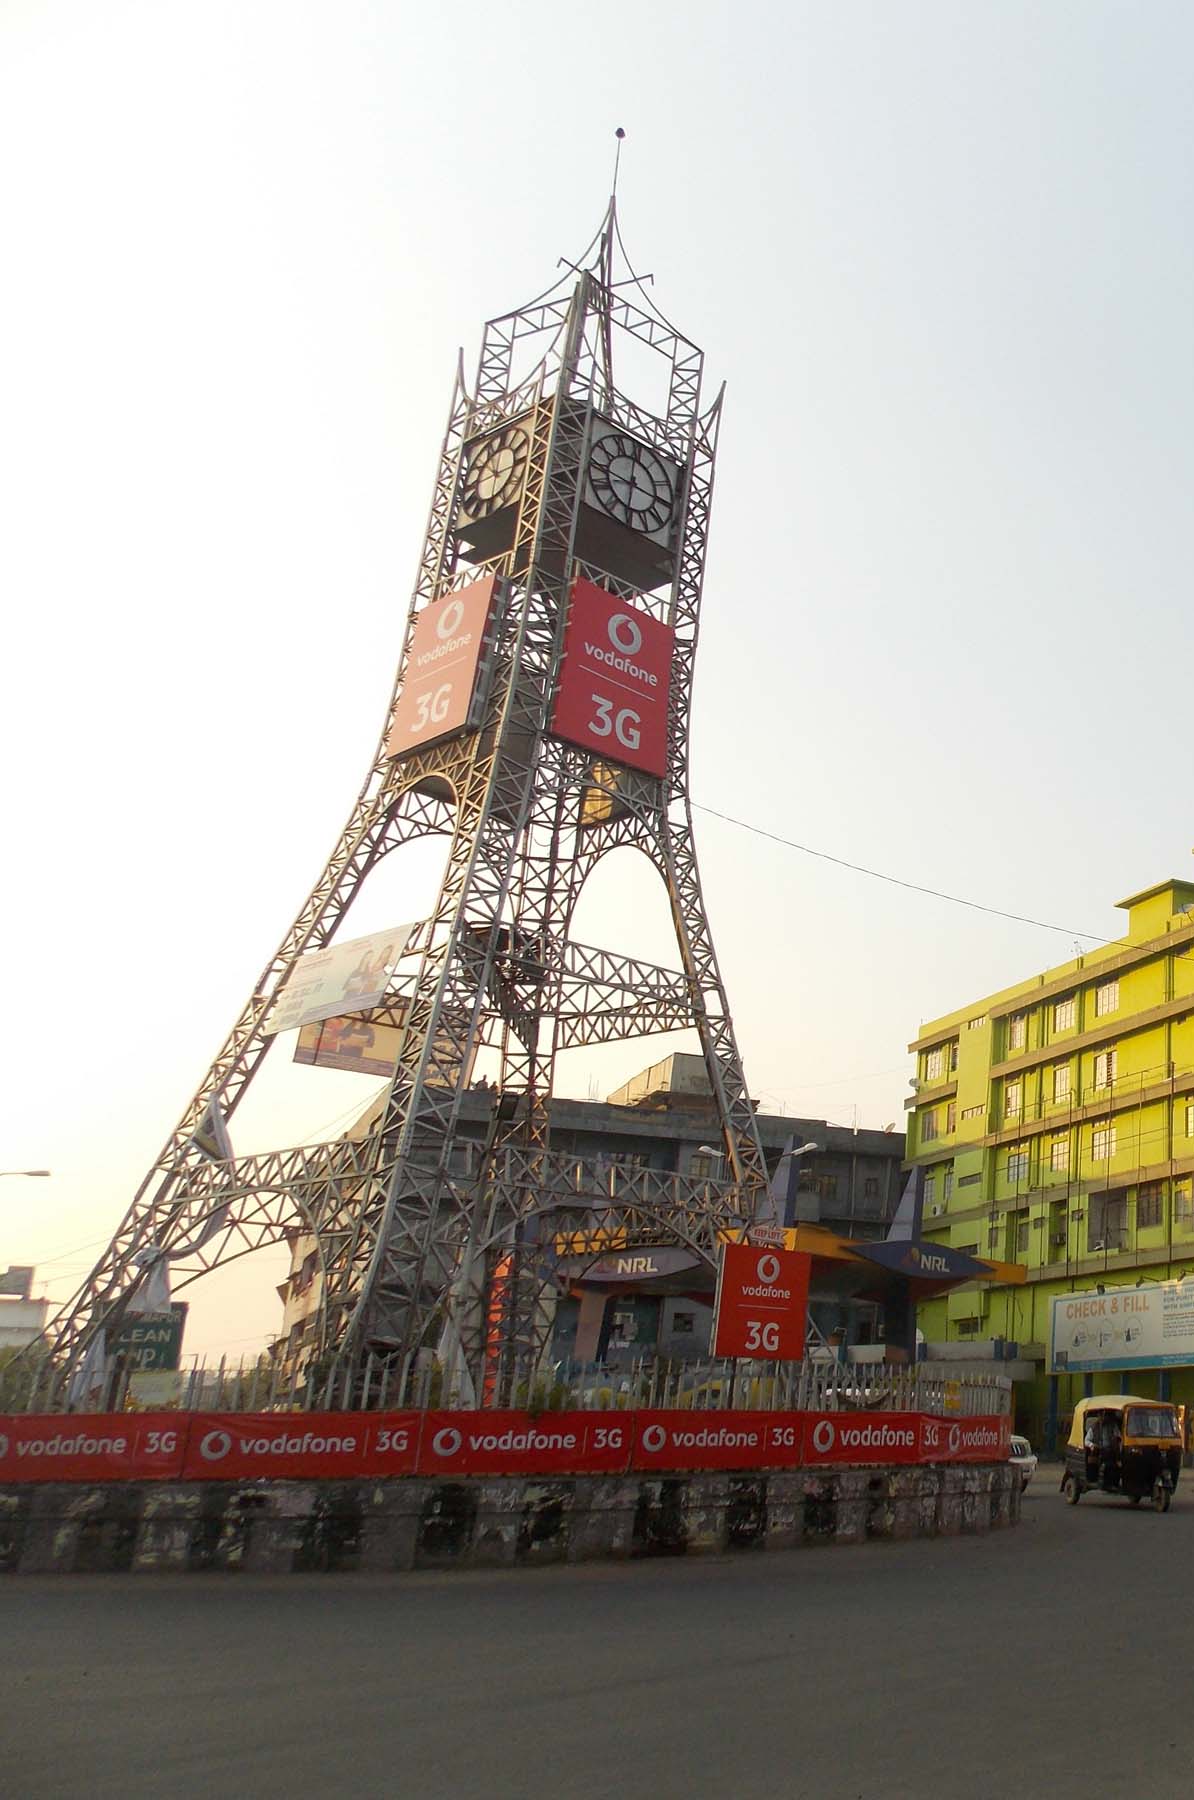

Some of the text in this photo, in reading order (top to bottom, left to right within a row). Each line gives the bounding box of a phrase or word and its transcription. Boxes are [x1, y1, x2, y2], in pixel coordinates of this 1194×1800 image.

[416, 632, 471, 666] vodafone
[584, 641, 658, 688] vodafone
[410, 683, 453, 733] 3G
[588, 694, 641, 750] 3G
[616, 1256, 658, 1274] NRL
[920, 1254, 951, 1273] NRL
[741, 1284, 791, 1300] vodafone
[1066, 1295, 1150, 1320] CHECK & FILL
[745, 1321, 780, 1351] 3G
[16, 1431, 177, 1457] vodafone 3G
[239, 1430, 408, 1457] vodafone 3G
[469, 1428, 623, 1452] vodafone 3G
[672, 1427, 795, 1448] vodafone 3G
[840, 1425, 939, 1447] vodafone 3G
[962, 1426, 998, 1447] vodafone
